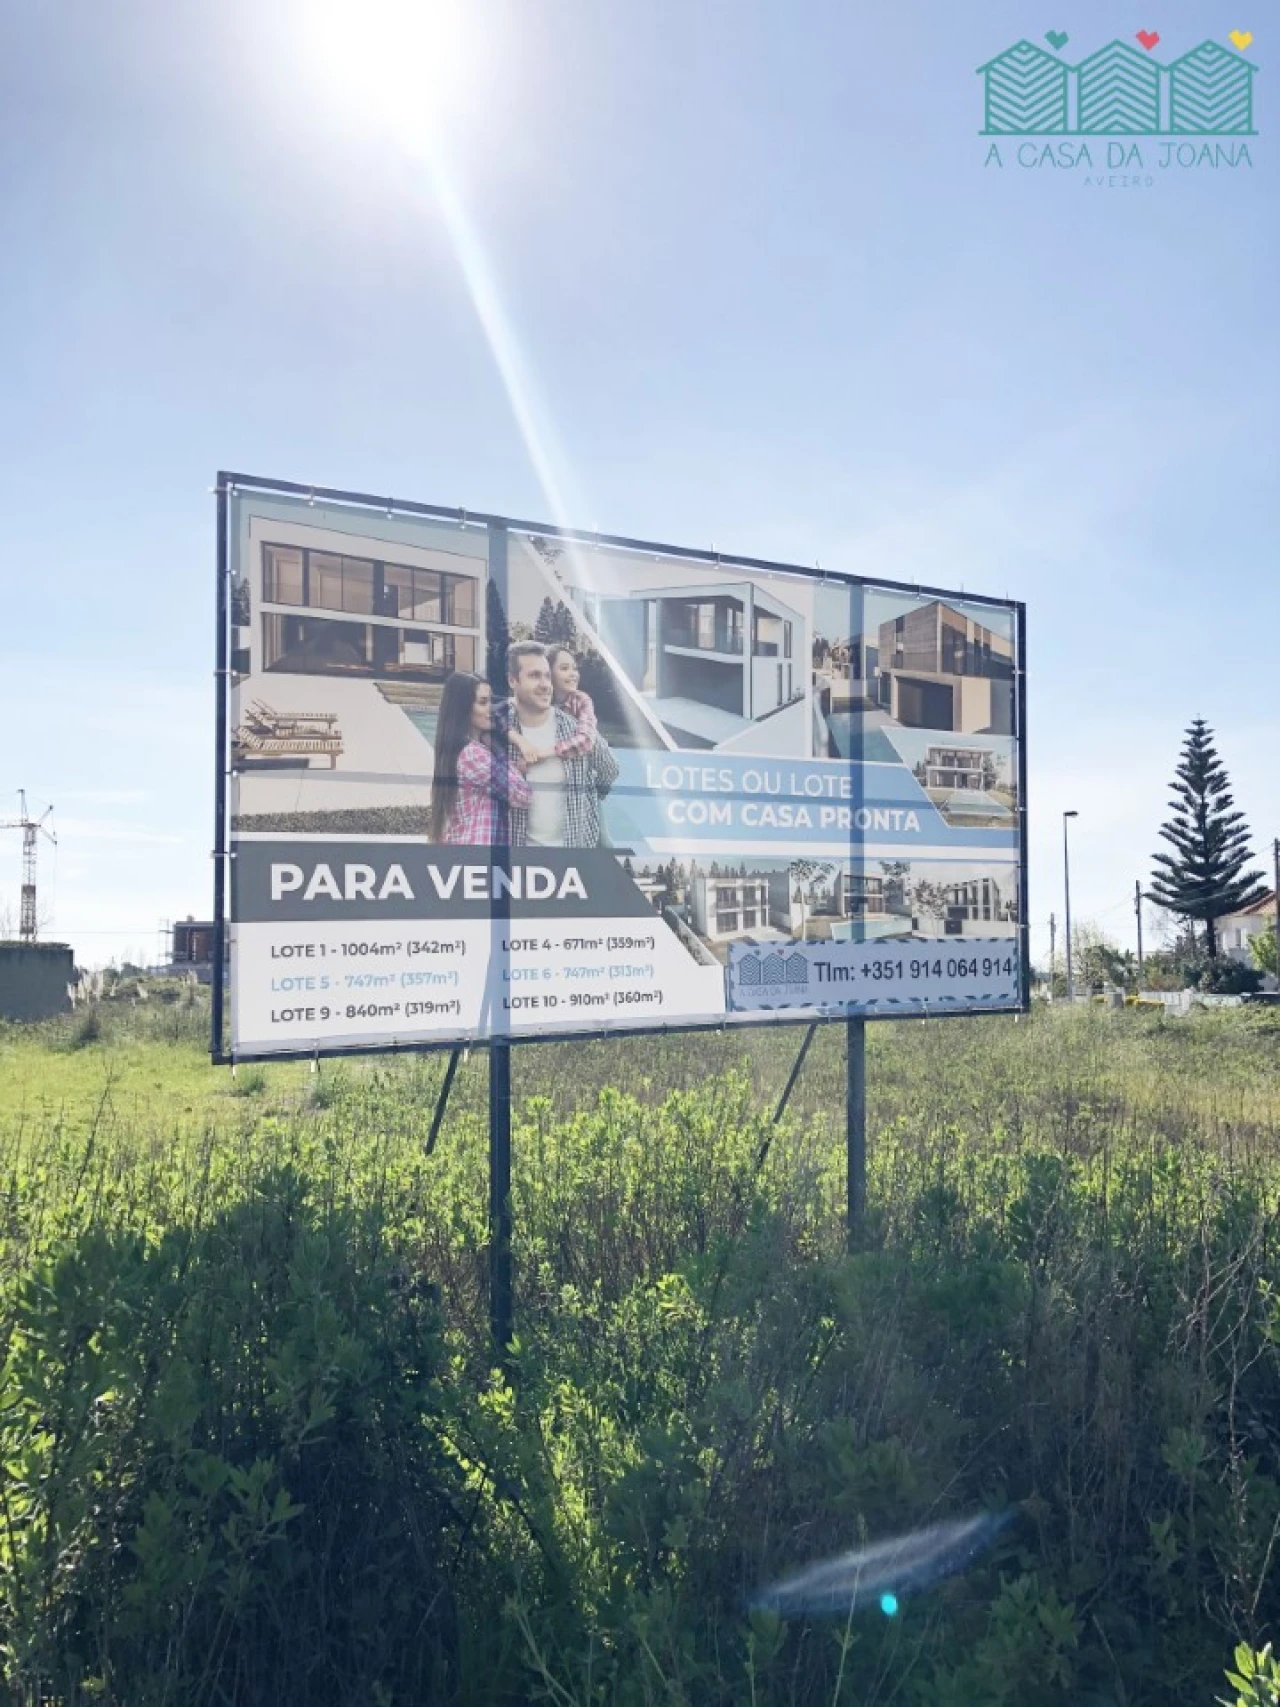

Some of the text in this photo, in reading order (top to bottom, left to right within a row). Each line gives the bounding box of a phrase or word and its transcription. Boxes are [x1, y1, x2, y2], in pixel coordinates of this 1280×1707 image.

[646, 763, 854, 799] LOTES OU LOTE
[667, 799, 921, 833] COM CASA PRONTA
[271, 863, 589, 900] PARA VENDA
[271, 943, 316, 959] LOTE
[319, 943, 327, 957] 1
[503, 938, 538, 951] LOTE
[542, 938, 552, 951] 4
[503, 968, 539, 981] LOTE
[543, 968, 552, 980] 6
[814, 957, 1012, 983] Tlm: +351 914 064 914
[271, 976, 316, 992] LOTE
[319, 975, 330, 990] 5
[503, 996, 539, 1009] LOTE
[543, 996, 558, 1008] 10
[271, 1007, 316, 1023] LOTE
[320, 1006, 331, 1020] 9
